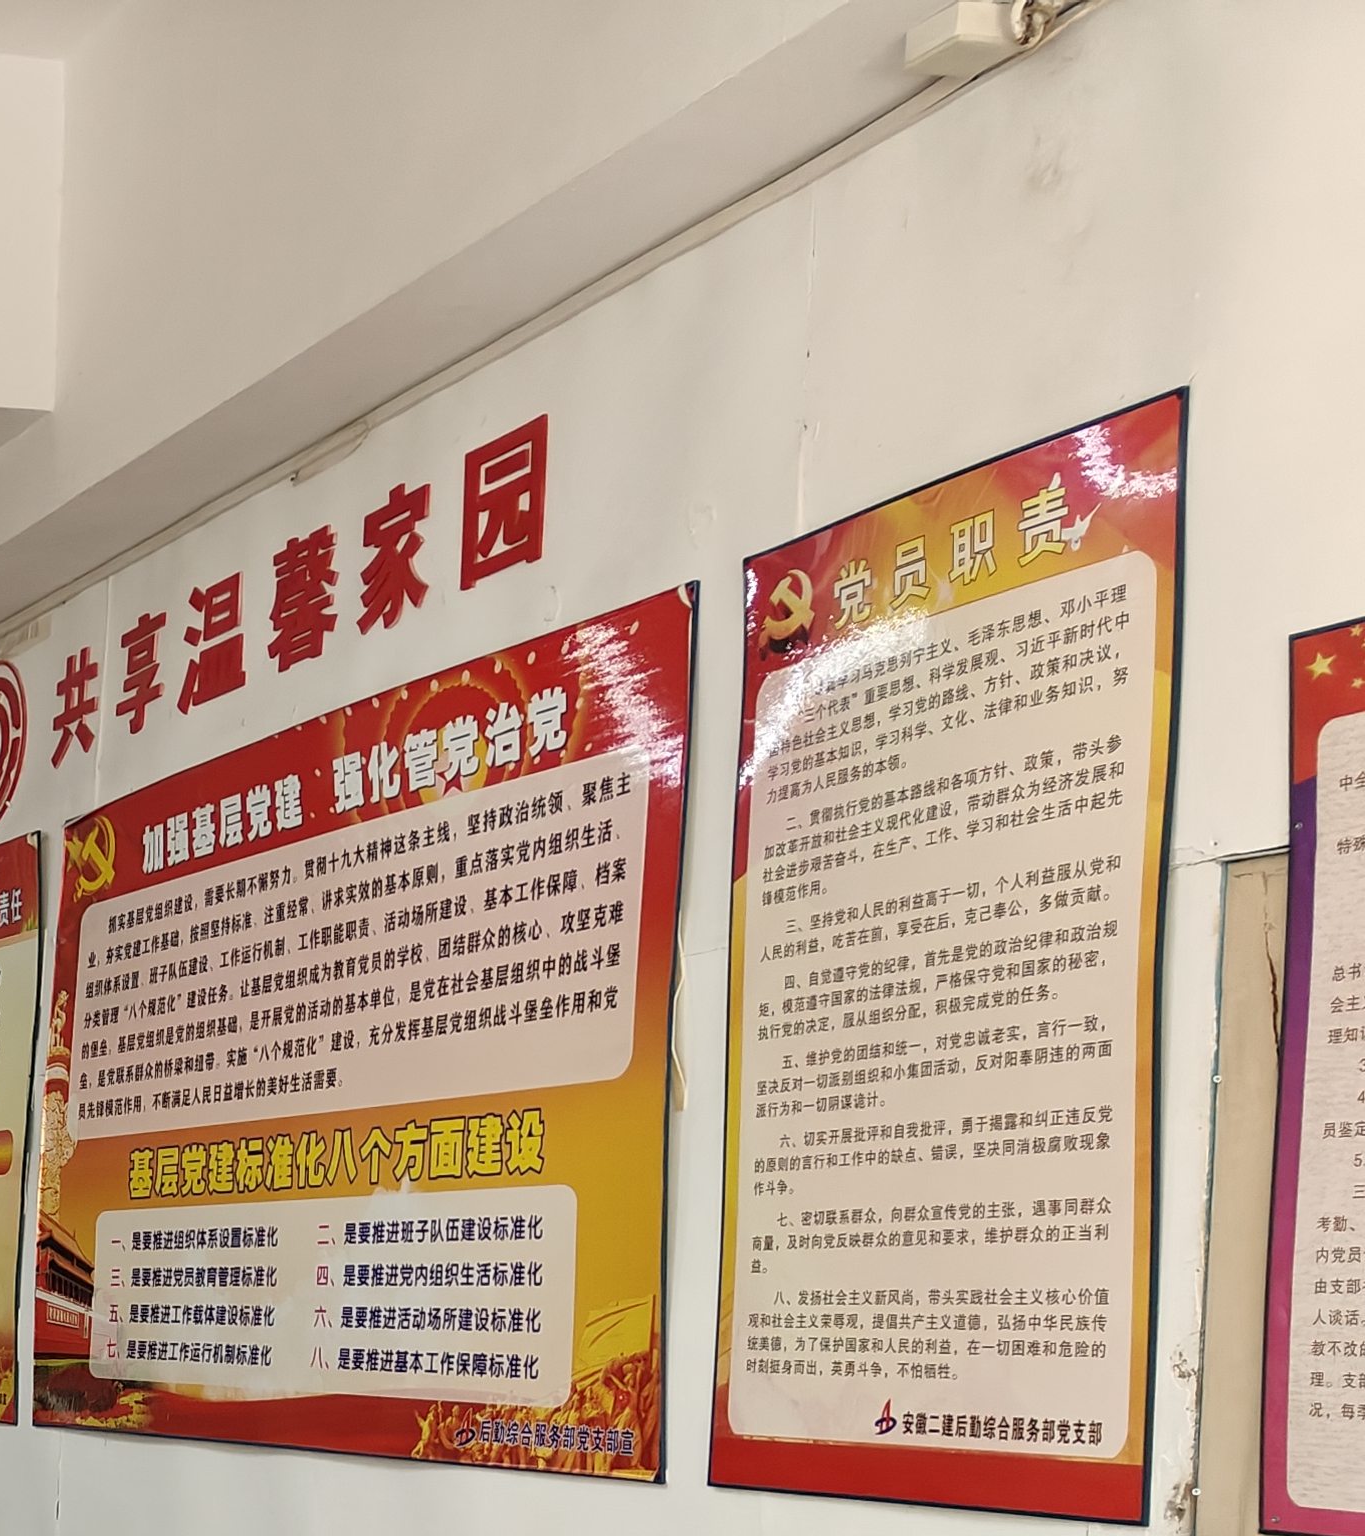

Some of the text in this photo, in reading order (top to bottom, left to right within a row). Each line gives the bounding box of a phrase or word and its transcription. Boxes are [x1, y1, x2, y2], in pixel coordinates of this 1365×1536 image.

[832, 484, 1069, 631] 党员职责
[52, 414, 548, 768] 共享温馨家园
[767, 665, 1128, 781] 学习党的基本知识，学习科学、文化、法律和业务知识，努
[140, 677, 568, 875] 加强基层党建 强化管党治党
[766, 750, 908, 805] 力提高为人民服务的本领。
[786, 732, 1122, 832] 二、贯彻执行党的基本路线和各项方针、政策，带头参
[763, 759, 1125, 861] 加改革开放和社会主义现代化建设，带动群众为经济发展和
[763, 787, 1123, 884] 社会进步艰苦奋斗，在生产、工作、学习和社会生活中起先
[761, 878, 828, 907] 锋模范作用。
[786, 854, 1121, 935] 三、坚持党和人民的利益高于一切，个人利益服从党和
[760, 883, 1112, 963] 人民的利益，吃苦在前，享受在后，克己奉公，多做贡献。
[784, 919, 1118, 991] 四、自觉遵守党的纪律，首先是党的政治纪律和政治规
[1332, 962, 1365, 982] 总书
[758, 949, 1106, 1018] 矩，模范遵守国家的法律法规，严格保守党和国家的秘密，
[757, 981, 1060, 1041] 执行党的决定，服从组织分配，积极完成党的任务。
[1330, 994, 1365, 1014] 会主
[782, 1012, 1107, 1071] 五、维护党的团结和统一，对党忠诚老实，言行一致，
[756, 1040, 1112, 1097] 坚决反对一切派别组织和小集团活动，反对阳奉阴违的两面
[756, 1090, 886, 1119] 派行为和一切阴谋诡计。
[780, 1105, 1112, 1150] 六、切实开展批评和自我批评，勇于揭露和纠正违反党
[127, 1106, 546, 1201] 基层党建标准化八个方面建设
[754, 1131, 1110, 1174] 的原则的言行和工作中的缺点、错误，坚决同消极腐败现象
[753, 1179, 795, 1196] 作斗争。
[777, 1195, 1111, 1228] 七、密切联系群众，向群众宣传党的主张，遇事同群众
[1317, 1215, 1355, 1232] 考勤、
[111, 1225, 278, 1253] 一、是要推进组织体系设置标准化
[316, 1213, 544, 1247] 二、是要推进班子队伍建设标准化
[751, 1223, 1109, 1252] 商量，及时向党反映群众的意见和要求，维护群众的正当利
[750, 1259, 768, 1274] 益。
[1315, 1246, 1365, 1264] 内党员
[110, 1265, 277, 1288] 三、是要推进党员教育管理标准化
[315, 1259, 543, 1287] 四、是要推进党内组织生活标准化
[1314, 1278, 1365, 1295] 由支部
[773, 1286, 1109, 1306] 八、发扬社会主义新风尚，带头实践社会主义核心价值
[108, 1304, 275, 1327] 五、是要推进工作载体建设标准化
[313, 1305, 541, 1334] 六、是要推进活动场所建设标准化
[748, 1313, 1107, 1332] 观和社会主义荣辱观，提倡共产主义道德，弘扬中华民族传
[106, 1338, 272, 1366] 七、是要推进工作运行机制标准化
[310, 1345, 538, 1380] 八、是要推进基本工作保障标准化
[747, 1336, 1106, 1359] 统美德，为了保护国家和人民的利益，在一切困难和危险的
[746, 1358, 958, 1381] 时刻挺身而出，英勇斗争，不怕牺牲。
[479, 1418, 635, 1457] 后勤综合服务部党支部宣
[902, 1411, 1102, 1447] 安徽二建后勤综合服务部党支部
